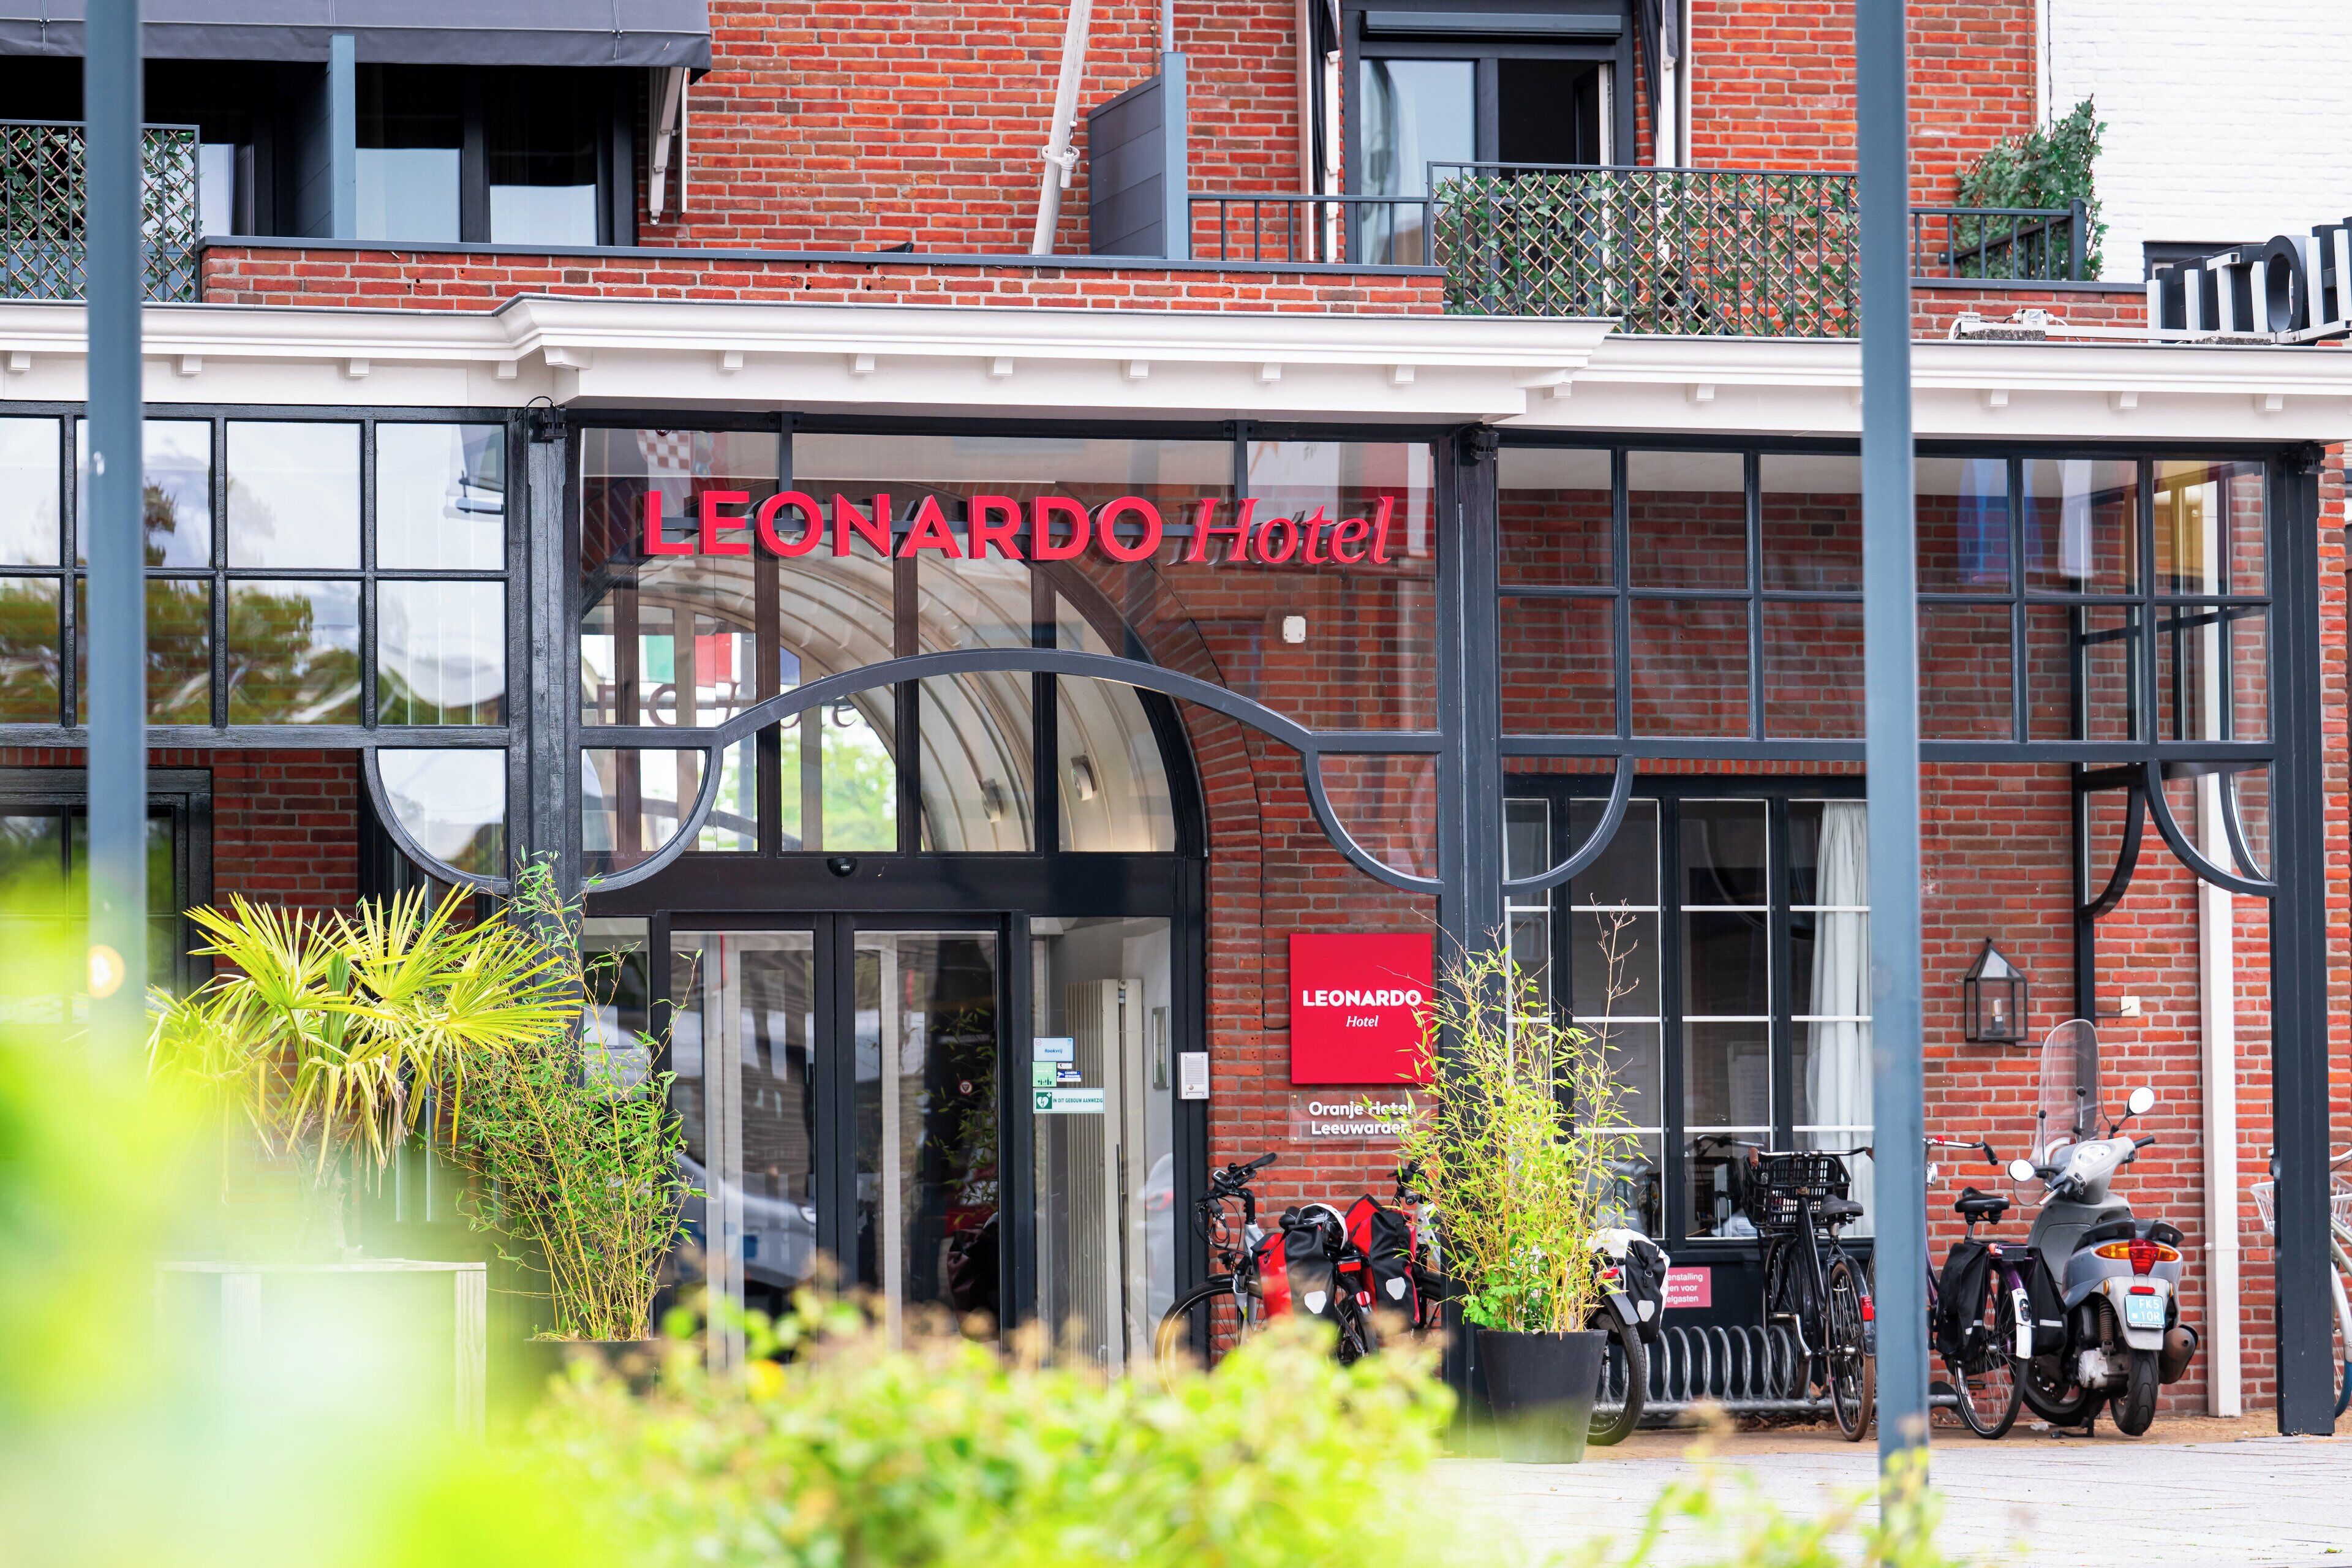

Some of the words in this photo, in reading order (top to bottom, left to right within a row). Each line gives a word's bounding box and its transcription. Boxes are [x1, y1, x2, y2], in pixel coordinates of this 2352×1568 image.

[644, 489, 1162, 562] LEONARDO
[1184, 496, 1395, 564] Hotel
[1302, 989, 1422, 1007] LEONARDO
[1346, 1015, 1379, 1027] Hotel
[1309, 1101, 1363, 1119] Oranje
[1368, 1101, 1411, 1115] Hotel
[1667, 1273, 1703, 1282] enstalling
[1666, 1295, 1698, 1305] elgasten
